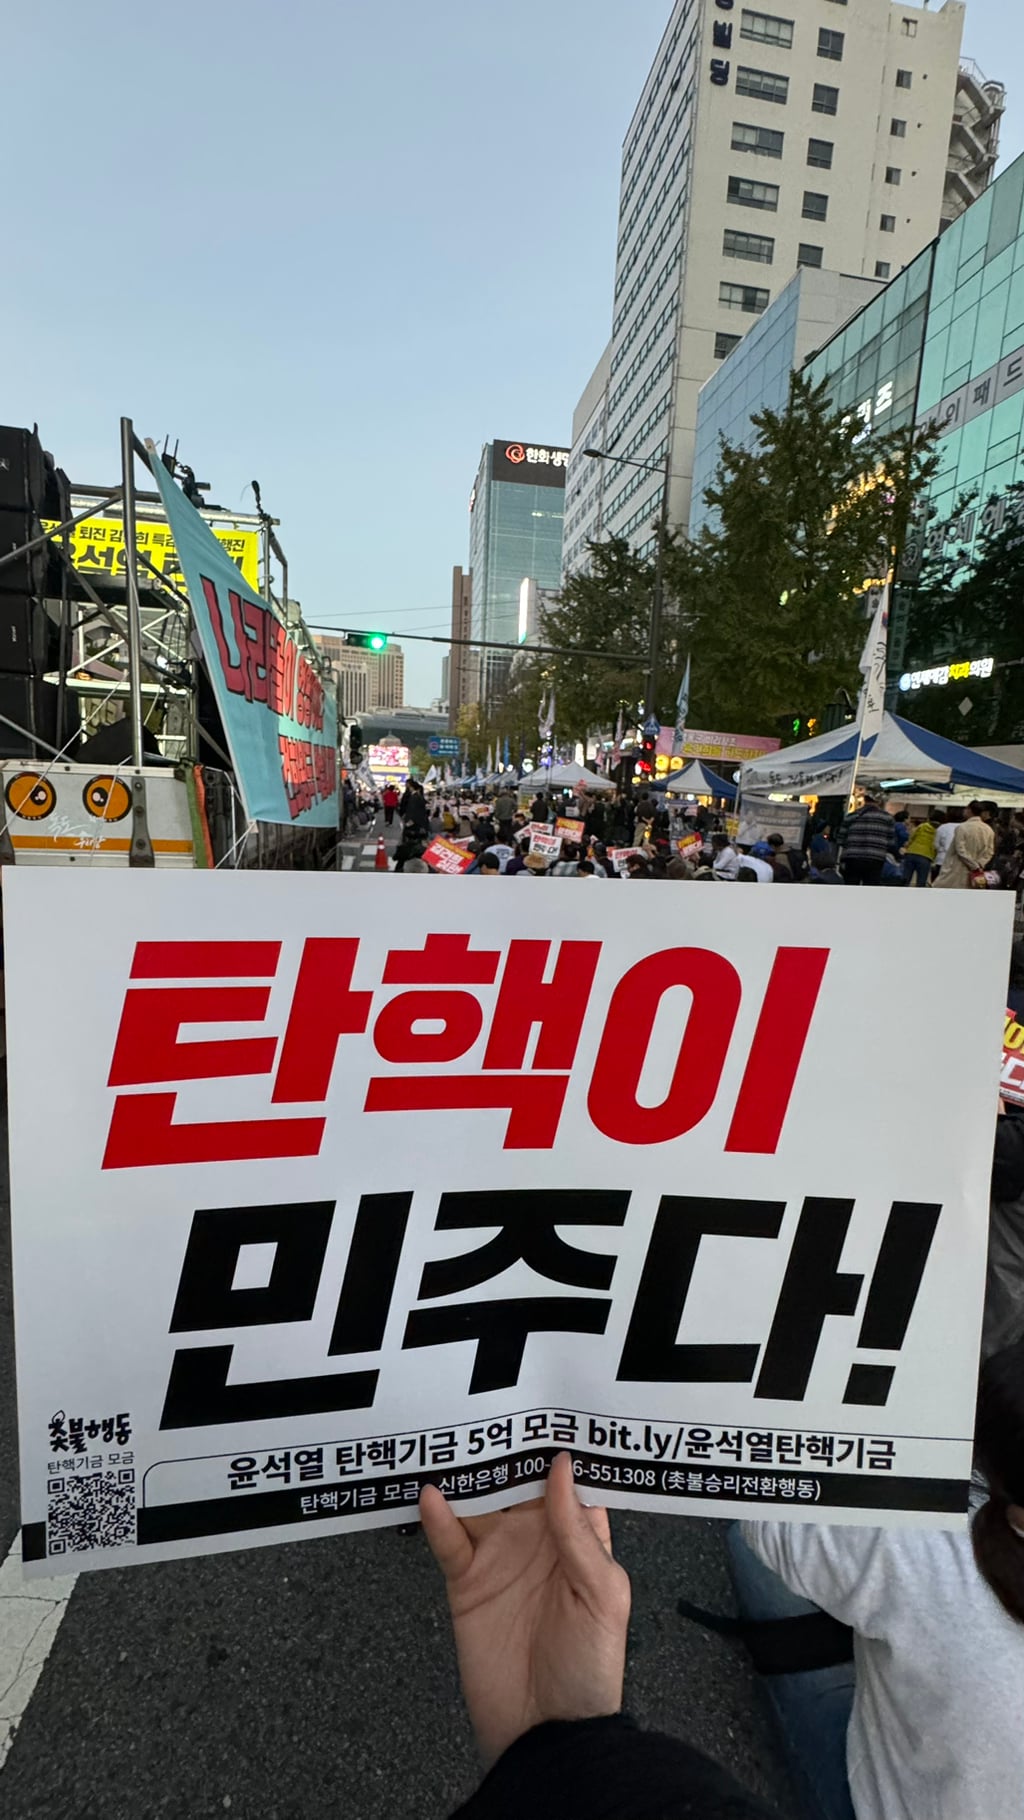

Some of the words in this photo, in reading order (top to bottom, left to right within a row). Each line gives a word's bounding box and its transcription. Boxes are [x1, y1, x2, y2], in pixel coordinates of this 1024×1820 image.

[710, 0, 734, 86] 빌딩
[80, 526, 106, 542] 퇴진
[110, 529, 149, 545] 김희
[101, 932, 831, 1171] 탄핵이
[158, 1189, 944, 1432] 민주다!
[47, 1455, 104, 1475] 탄핵기금
[108, 1451, 135, 1466] 모금
[48, 1410, 132, 1454] 촛불행동
[227, 1446, 326, 1491] 윤석열
[335, 1431, 459, 1477] 탄핵기금
[467, 1421, 513, 1456] 5억
[521, 1412, 579, 1444] 모금
[587, 1419, 897, 1471] bit.ly/윤석열탄핵기금
[300, 1488, 377, 1515] 탄핵기금
[382, 1481, 421, 1501] 모금
[438, 1464, 509, 1495] 신한은행
[513, 1456, 656, 1487] 100-6-551308
[661, 1470, 822, 1501] (촛불승리전환행동)
